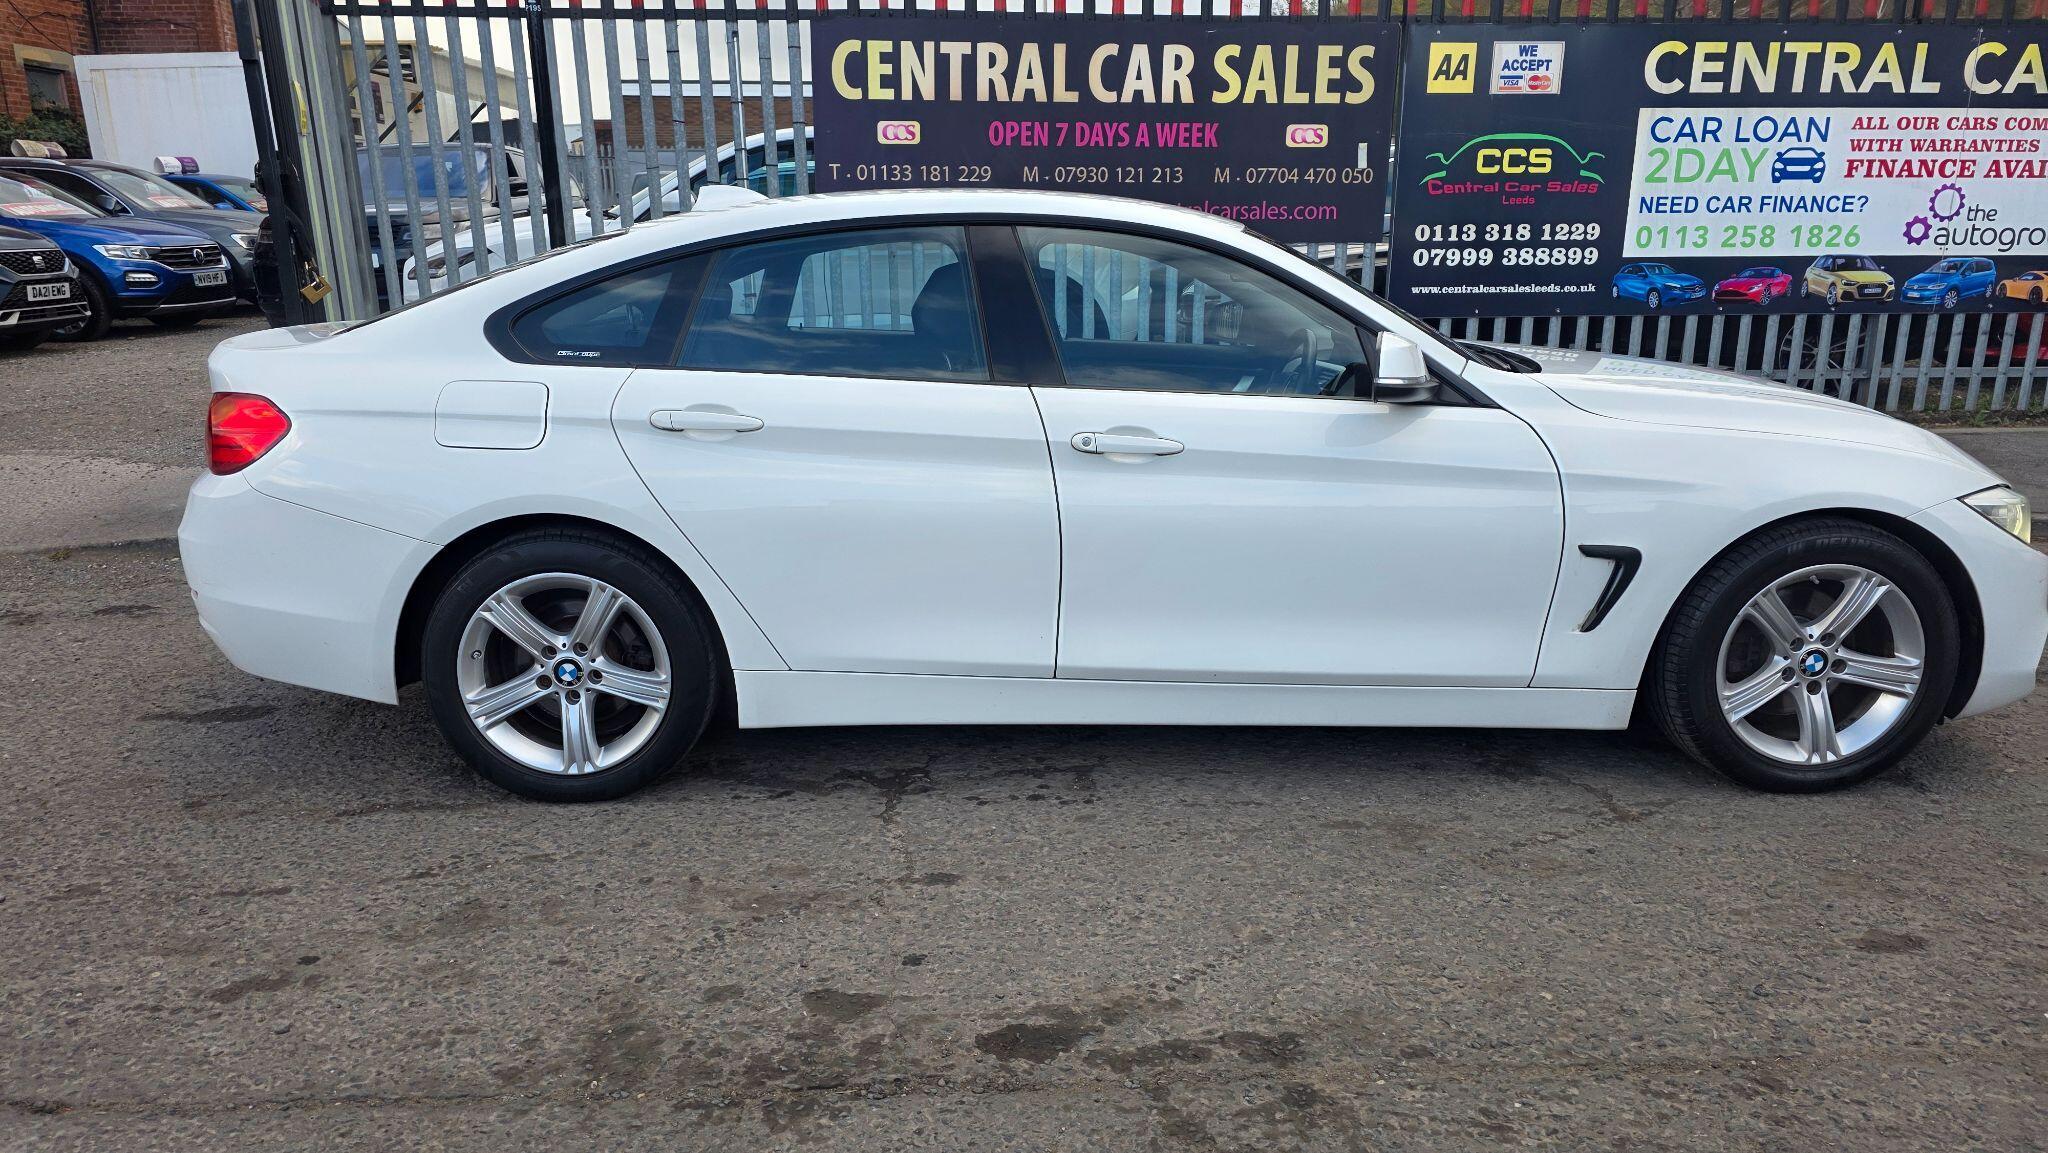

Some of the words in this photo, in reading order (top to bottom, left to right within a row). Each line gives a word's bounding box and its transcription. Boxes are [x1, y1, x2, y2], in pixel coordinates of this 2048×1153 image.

[1518, 44, 1539, 57] WE
[831, 39, 1079, 103] CENTRAL
[1088, 43, 1195, 104] CAR
[1211, 43, 1376, 105] SALES
[1432, 53, 1470, 81] AA
[1501, 59, 1553, 72] ACCEPT
[1644, 40, 1941, 95] CENTRAL
[1963, 41, 2048, 95] CA
[881, 124, 917, 141] CCS
[1650, 115, 1723, 143] CAR
[1734, 115, 1831, 143] LOAN
[1851, 116, 1890, 131] ALL
[1896, 116, 1940, 131] OUR
[1946, 116, 1999, 131] CARS
[2003, 116, 2048, 131] COM
[988, 120, 1049, 147] OPEN
[1054, 122, 1070, 147] 7
[1075, 121, 1130, 148] DAYS
[1135, 122, 1150, 148] A
[1155, 122, 1219, 148] WEEK
[1290, 127, 1324, 144] CCS
[1849, 138, 1904, 152] WITH
[1910, 138, 2041, 153] WARRANTIES
[1476, 148, 1553, 174] CCS
[1644, 147, 1770, 184] 2DAY
[1844, 158, 1977, 179] FINANCE
[856, 164, 912, 181] 01133
[920, 165, 949, 182] 181
[957, 165, 992, 182] 229
[1054, 166, 1109, 183] 07930
[1115, 167, 1143, 183] 121
[1151, 167, 1184, 183] 213
[1245, 168, 1299, 184] 07704
[1304, 168, 1337, 184] 470
[1341, 168, 1374, 184] 050
[1427, 179, 1499, 195] Central
[1504, 181, 1542, 193] Car
[1546, 181, 1599, 194] Sales
[1502, 195, 1536, 205] Leeds
[1638, 196, 1699, 214] NEED
[1705, 195, 1753, 213] CAR
[1758, 195, 1870, 213] FINANCE?
[1966, 203, 1998, 221] the
[1414, 223, 1477, 241] 0113
[1484, 223, 1531, 241] 318
[1540, 222, 1601, 241] 1229
[1635, 225, 1709, 249] 0113
[1720, 225, 1776, 248] 258
[1789, 224, 1862, 248] 1826
[1412, 247, 1494, 267] 07999
[1501, 246, 1599, 266] 388899
[1411, 283, 1596, 294] www.centralcarsalesleeds.co.uk
